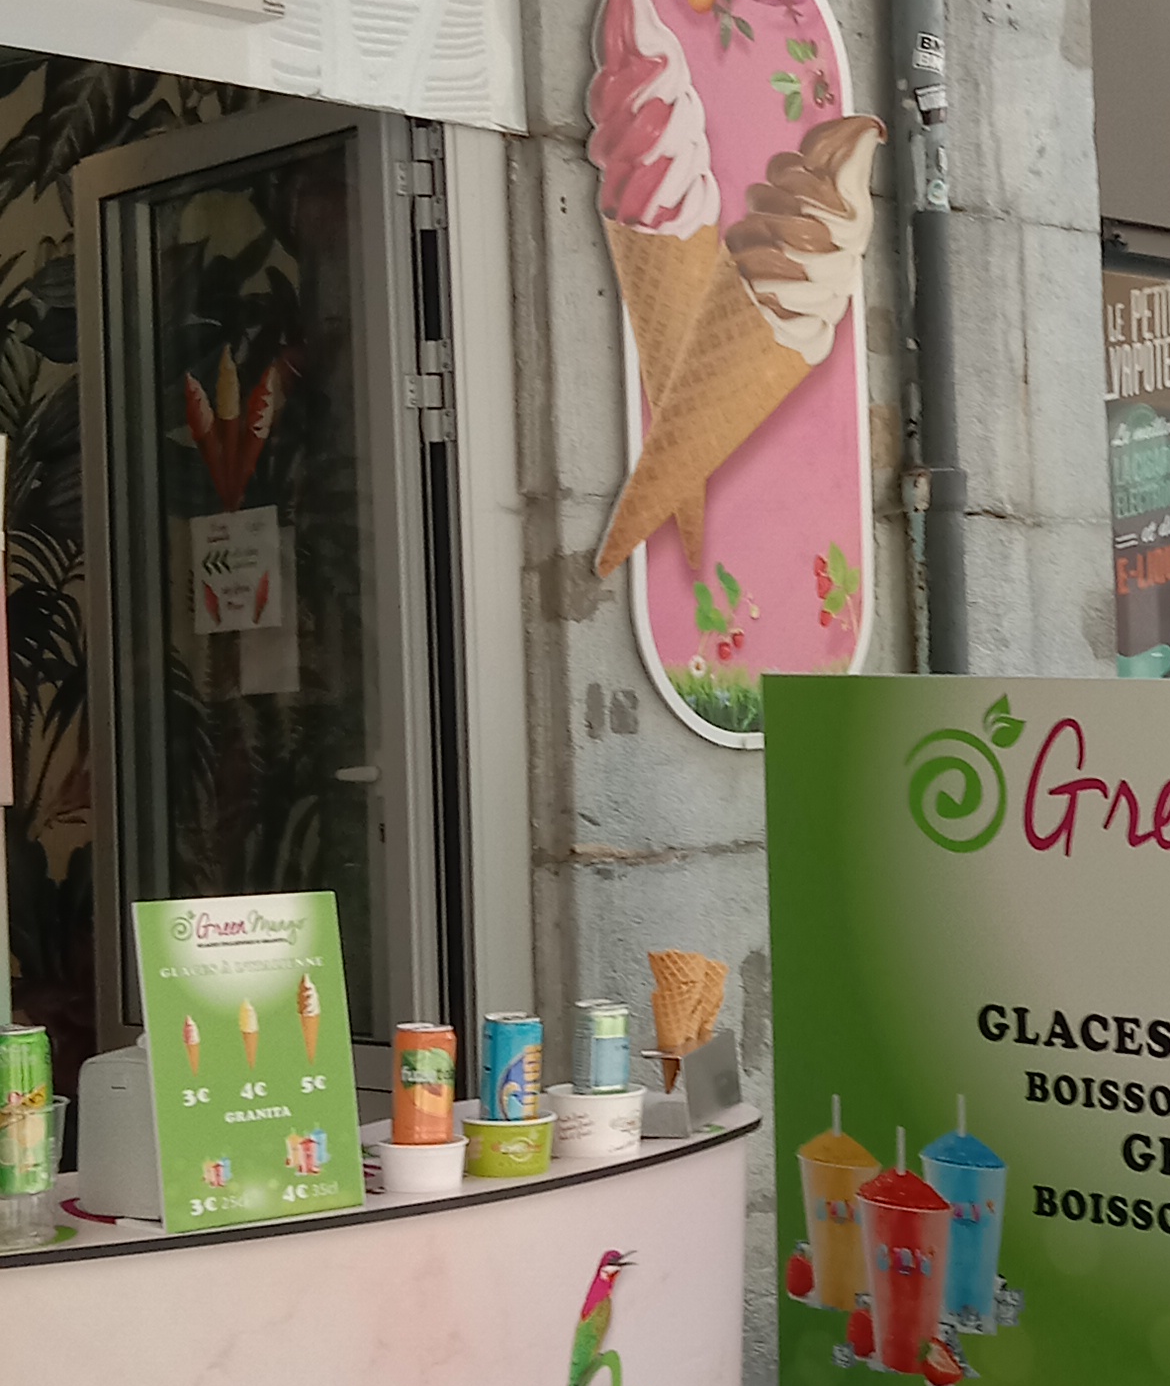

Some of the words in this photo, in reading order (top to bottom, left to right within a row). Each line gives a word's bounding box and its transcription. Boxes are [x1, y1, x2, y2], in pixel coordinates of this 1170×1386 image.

[1107, 302, 1126, 343] LE
[182, 1088, 211, 1107] 3€
[240, 1082, 268, 1100] 4€
[301, 1075, 327, 1094] 5€
[224, 1106, 292, 1123] GRANITA
[282, 1184, 309, 1202] 4€
[190, 1197, 218, 1216] 3€
